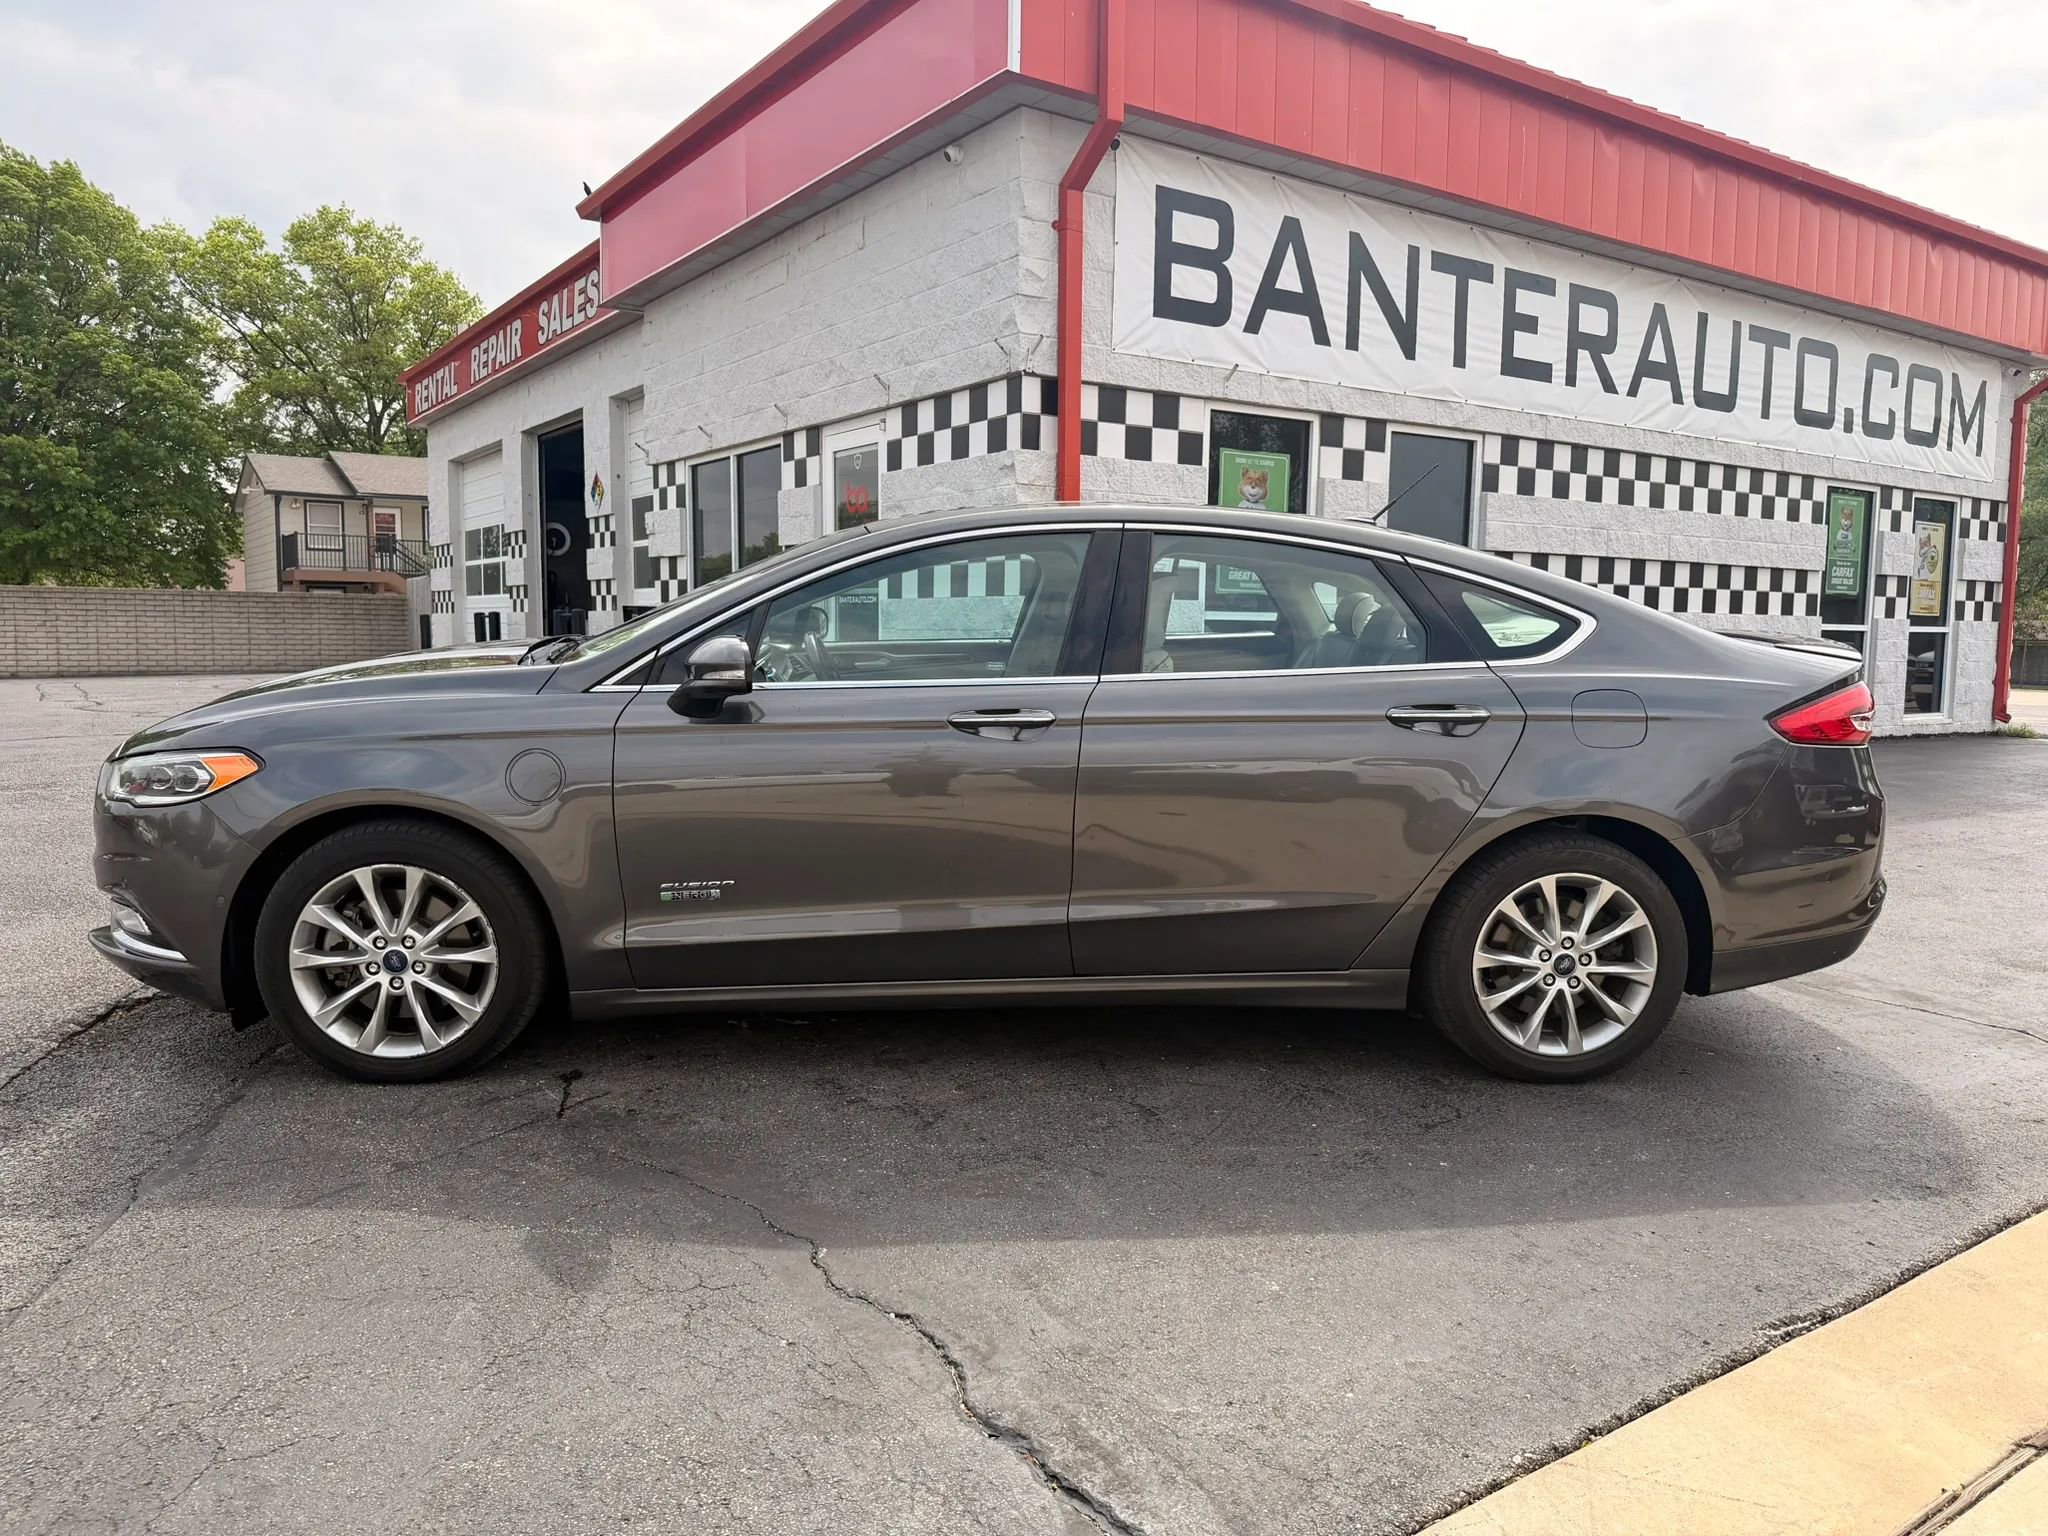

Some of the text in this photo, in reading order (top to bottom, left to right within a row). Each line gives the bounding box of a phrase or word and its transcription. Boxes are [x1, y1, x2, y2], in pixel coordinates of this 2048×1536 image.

[415, 269, 600, 416] RENTAL REPAIR SALES
[1153, 184, 1986, 457] BANTERAUTO.COM
[1230, 570, 1252, 580] GREAT
[1832, 566, 1854, 578] CARFAX
